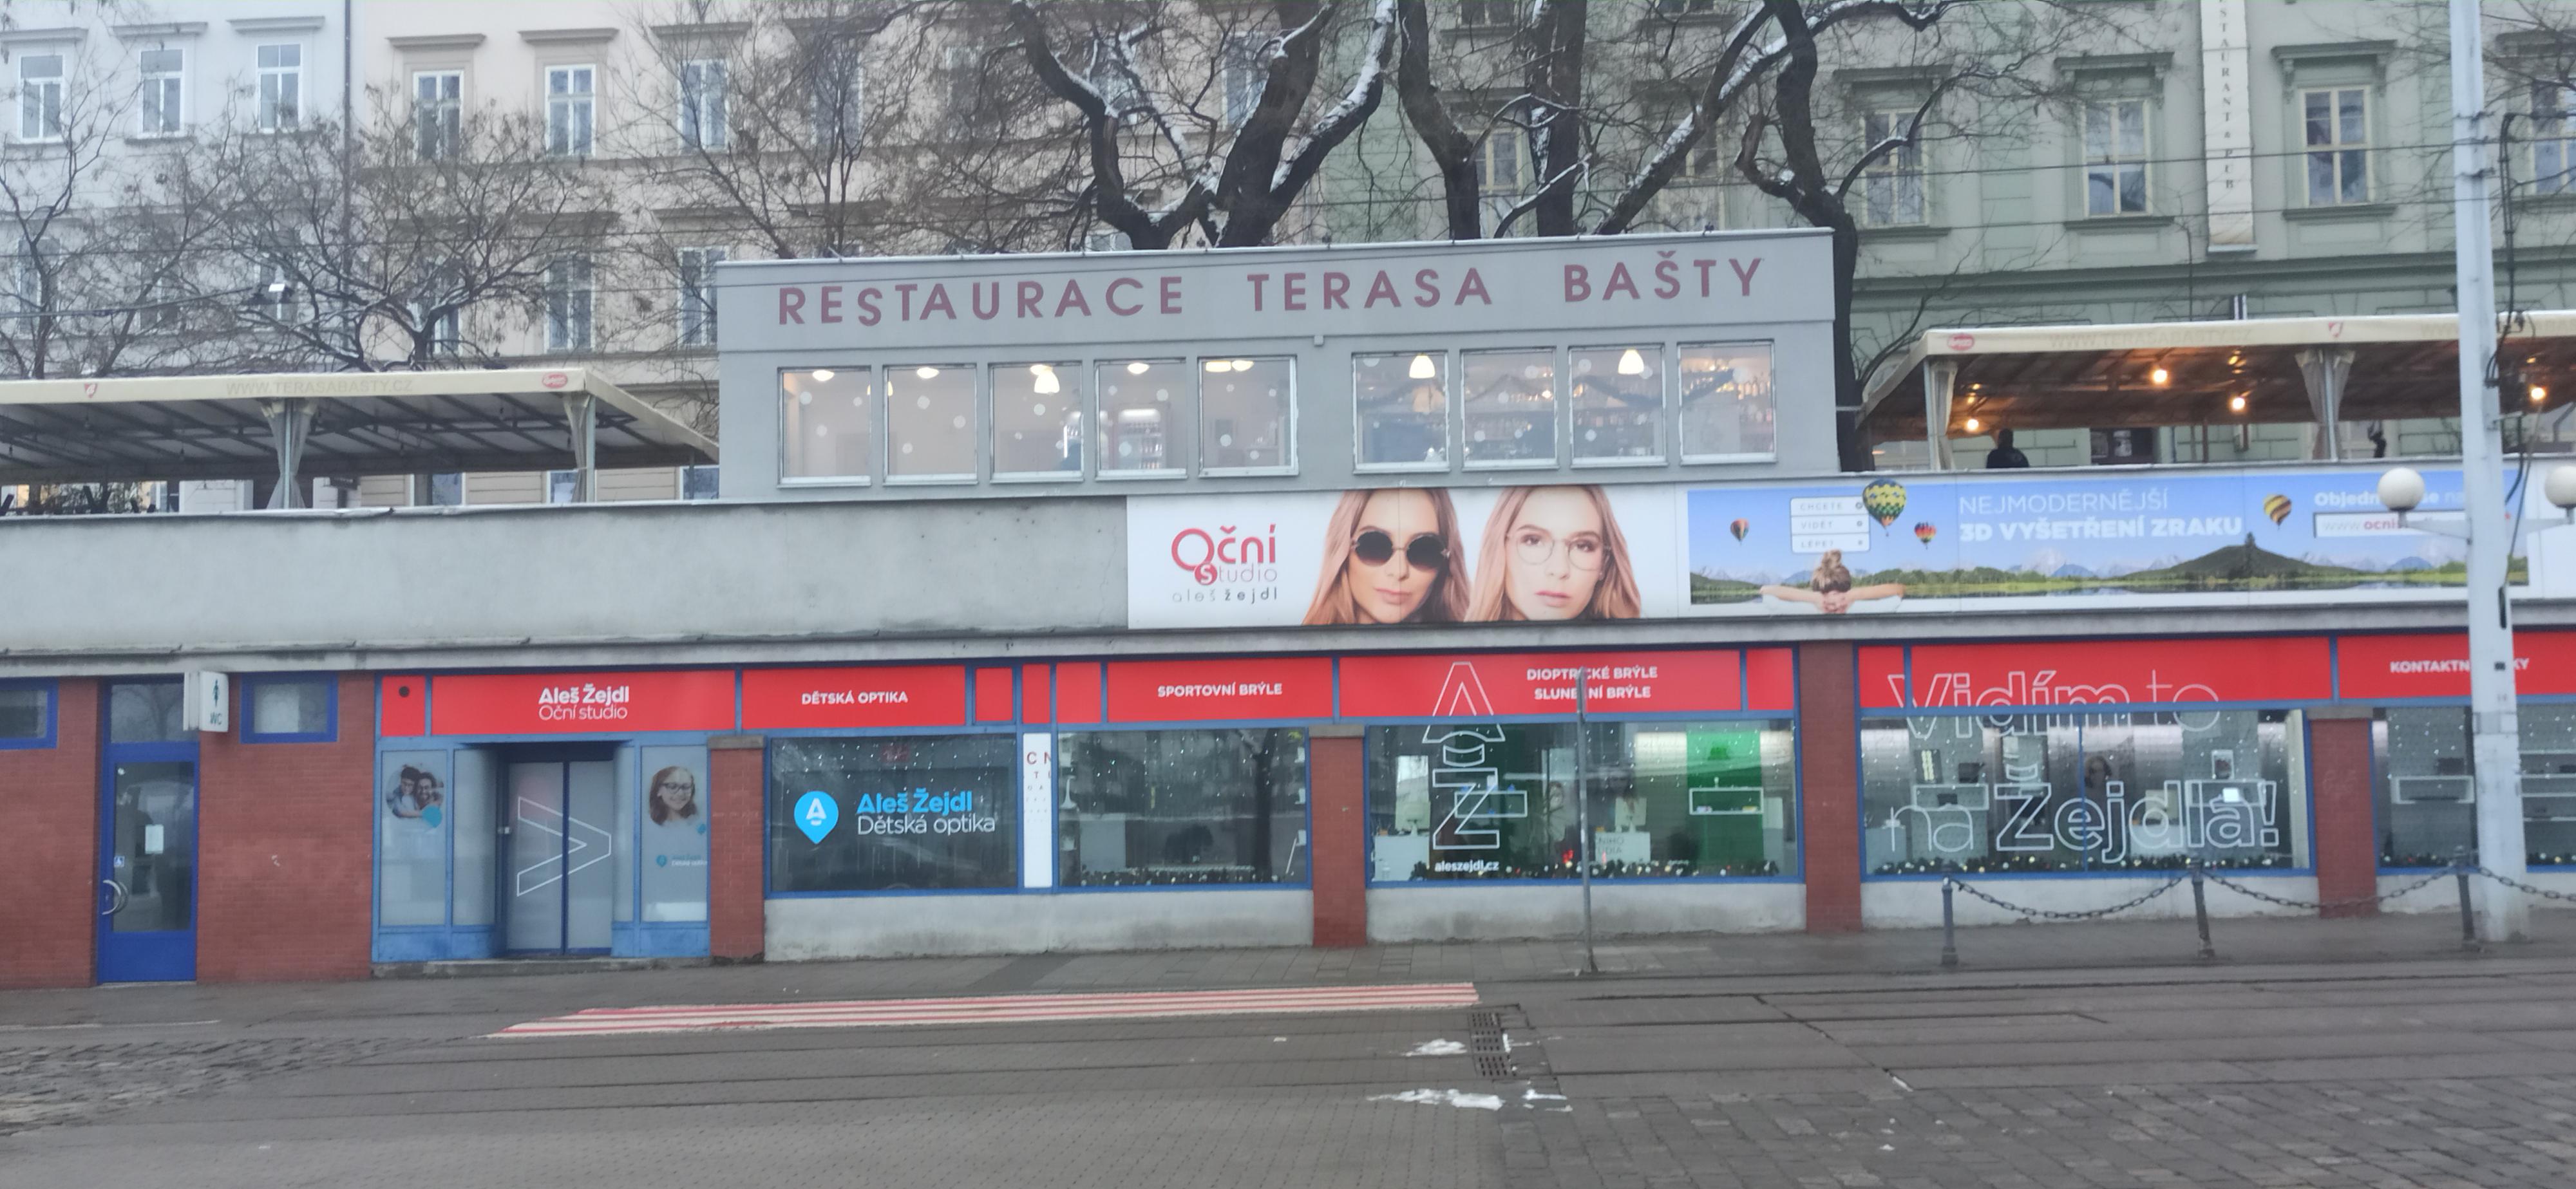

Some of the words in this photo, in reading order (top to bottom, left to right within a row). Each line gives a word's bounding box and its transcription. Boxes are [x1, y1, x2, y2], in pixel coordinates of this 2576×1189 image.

[2219, 0, 2231, 122] STAURANT
[779, 276, 1183, 326] RESTAURACE
[1247, 267, 1493, 312] TERASA
[1564, 250, 1764, 303] BAŠTY
[1959, 487, 2169, 515] NEJMODERNĚJŠÍ
[1959, 522, 1993, 541] 3D
[1999, 516, 2145, 541] VYŠETŘENÍ
[2151, 517, 2242, 538] ZRAKU
[1171, 523, 1276, 572] Oční
[1613, 665, 1658, 679] BRÝLE
[2390, 659, 2470, 673] KONTAKTN
[538, 686, 580, 704] Aleš
[582, 682, 629, 706] Žejdl
[801, 689, 855, 705] DĚTSKÁ
[858, 691, 908, 704] OPTIKA
[1157, 682, 1236, 698] SPORTOVNÍ
[1239, 680, 1283, 697] BRÝLE
[1535, 685, 1603, 700] SLUNENÍ
[1607, 684, 1651, 699] BRÝLE
[538, 704, 577, 720] Oční
[579, 704, 628, 720] studio
[1887, 670, 2130, 739] Vidím
[210, 712, 223, 726] WC
[856, 792, 908, 814] Aleš
[912, 787, 973, 816] Žejdl
[857, 812, 927, 836] Dětská
[933, 814, 996, 836] optika
[1994, 763, 2280, 865] Žejdla!
